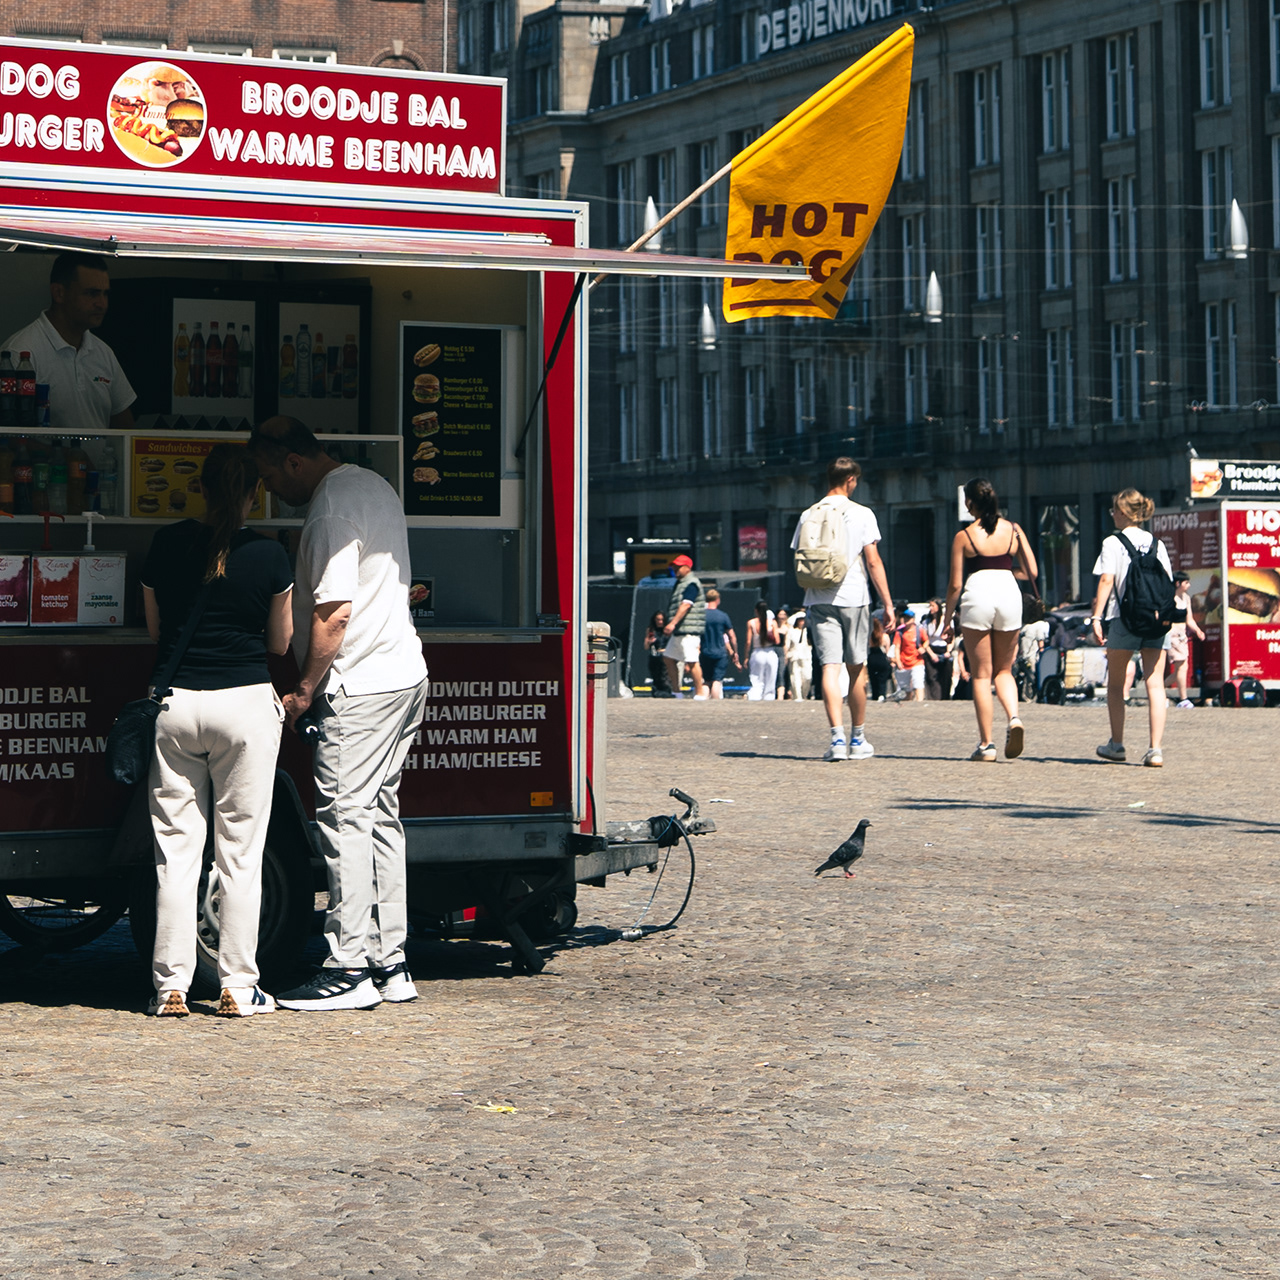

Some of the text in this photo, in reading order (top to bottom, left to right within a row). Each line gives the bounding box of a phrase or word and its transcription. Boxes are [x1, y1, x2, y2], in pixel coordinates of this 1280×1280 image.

[758, 8, 787, 55] DE
[0, 61, 81, 100] DOG
[241, 80, 468, 130] BROODJE BAL
[208, 126, 496, 179] WARME BEENHAM
[750, 202, 869, 238] HOT
[731, 249, 843, 288] DOG
[147, 442, 202, 453] Sandwiches
[1153, 512, 1199, 532] HOTDOGS
[49, 686, 92, 704] BAL
[427, 680, 559, 698] DWICH DUTCH
[425, 704, 546, 721] HAMBURGER
[426, 728, 489, 745] WARM
[493, 727, 537, 744] HAM
[423, 751, 542, 770] HAM/CHEESE
